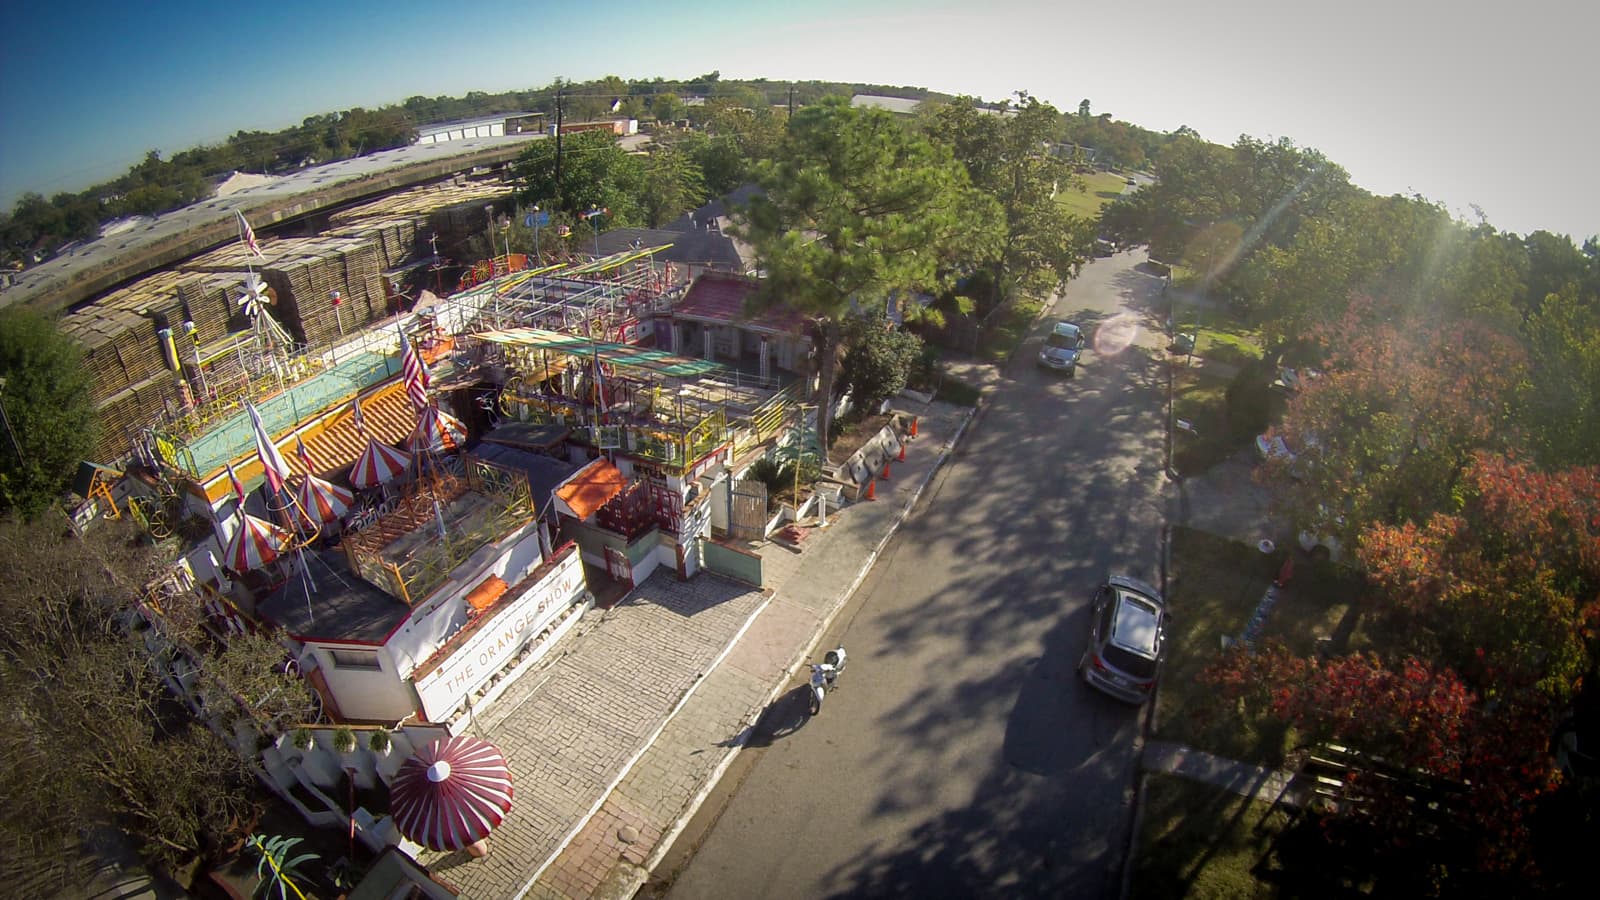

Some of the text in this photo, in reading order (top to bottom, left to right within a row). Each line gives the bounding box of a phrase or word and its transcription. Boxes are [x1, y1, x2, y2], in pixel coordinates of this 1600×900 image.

[446, 579, 572, 693] THE ORANGE SHOW
